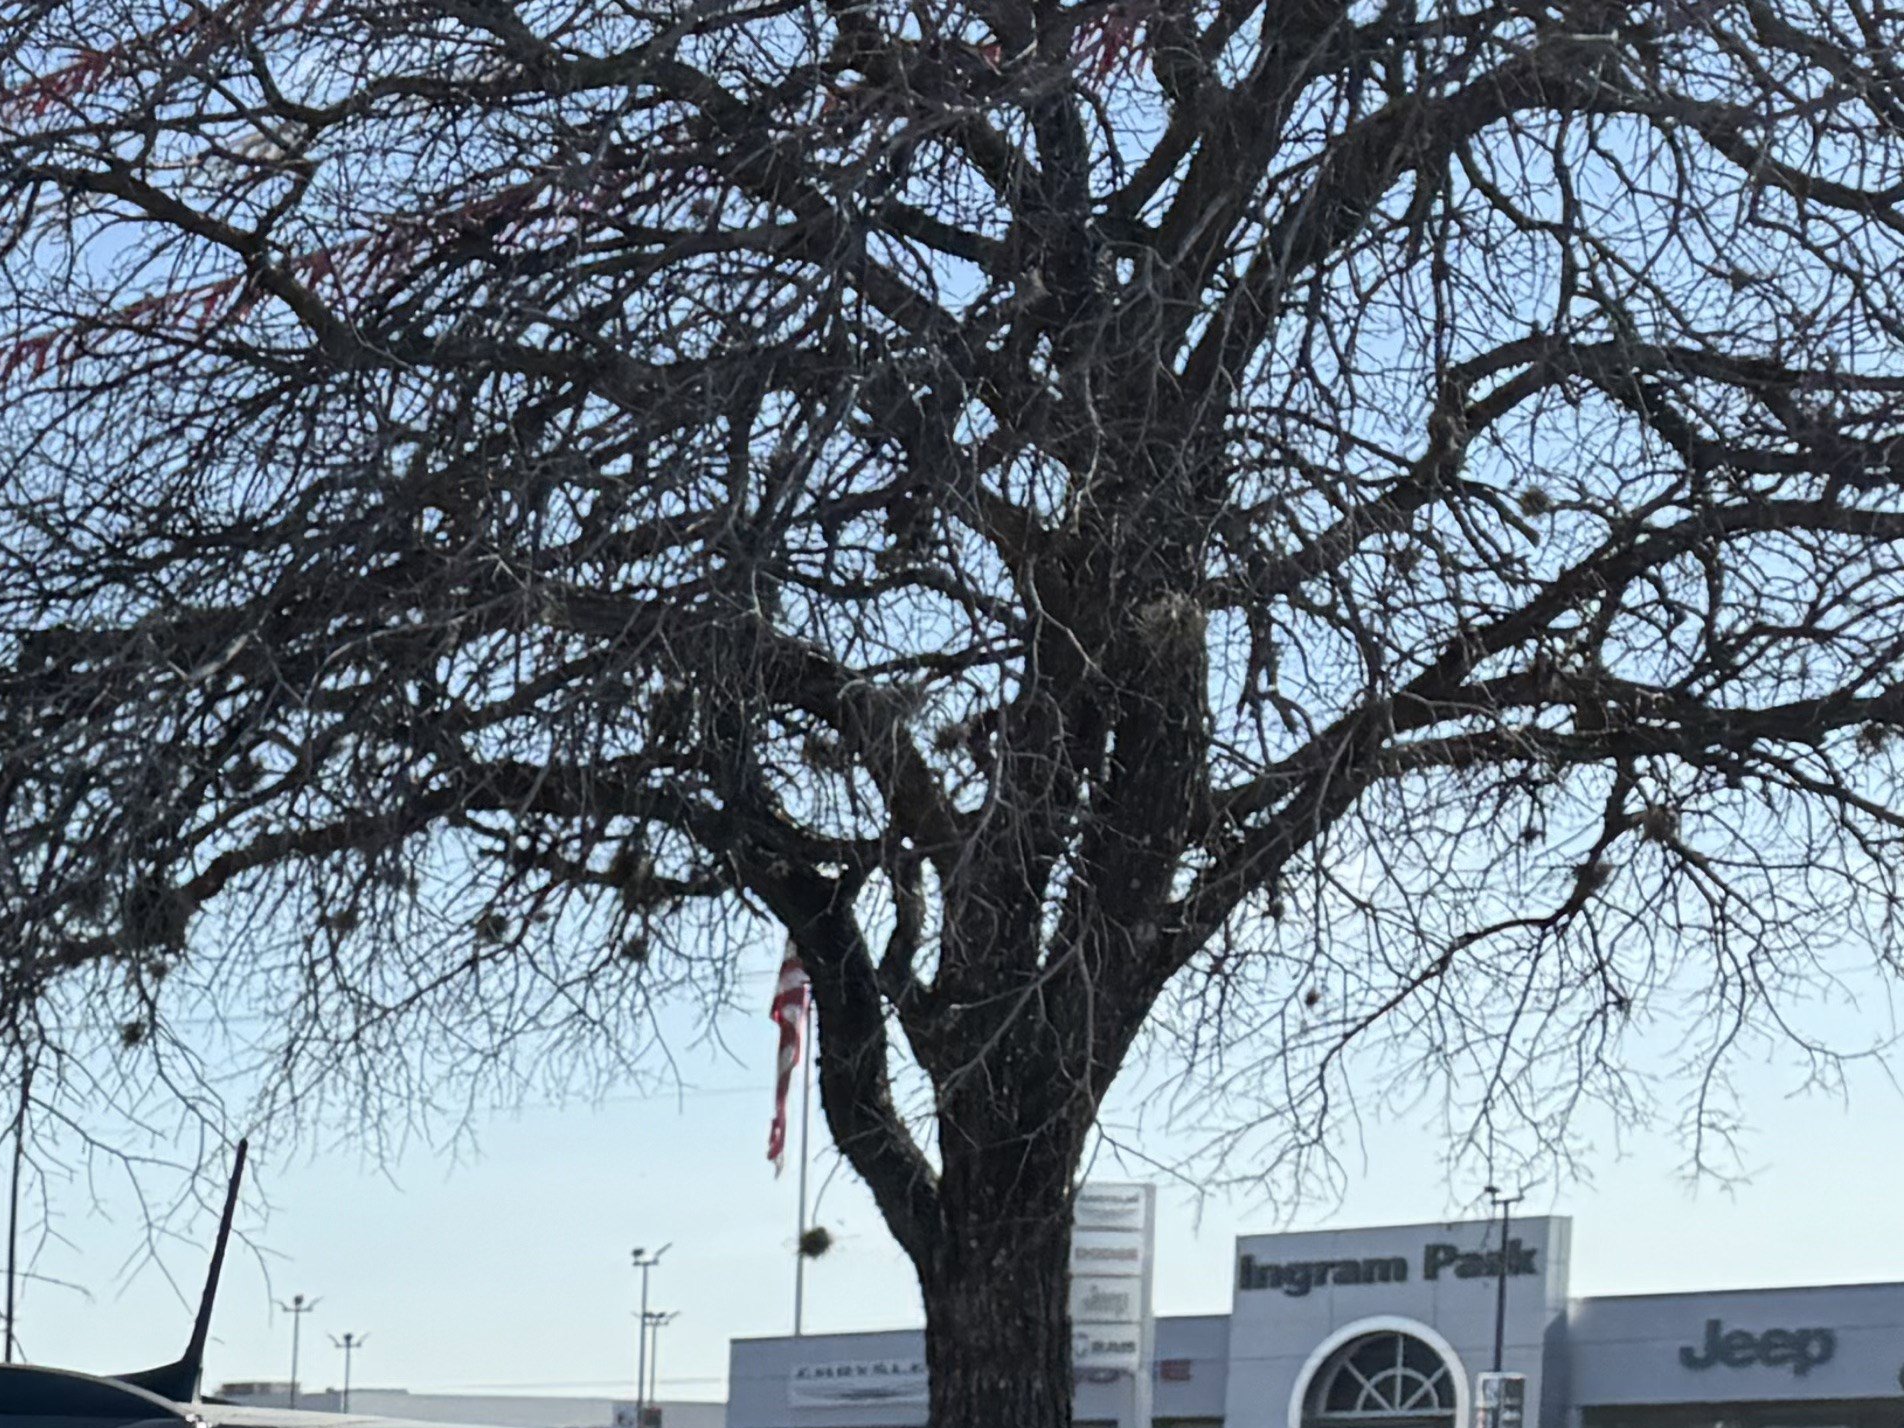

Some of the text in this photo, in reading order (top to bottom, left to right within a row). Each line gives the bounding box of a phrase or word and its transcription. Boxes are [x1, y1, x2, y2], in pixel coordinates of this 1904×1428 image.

[1239, 1238, 1540, 1297] Ingram Park
[1679, 1319, 1837, 1377] Jeep
